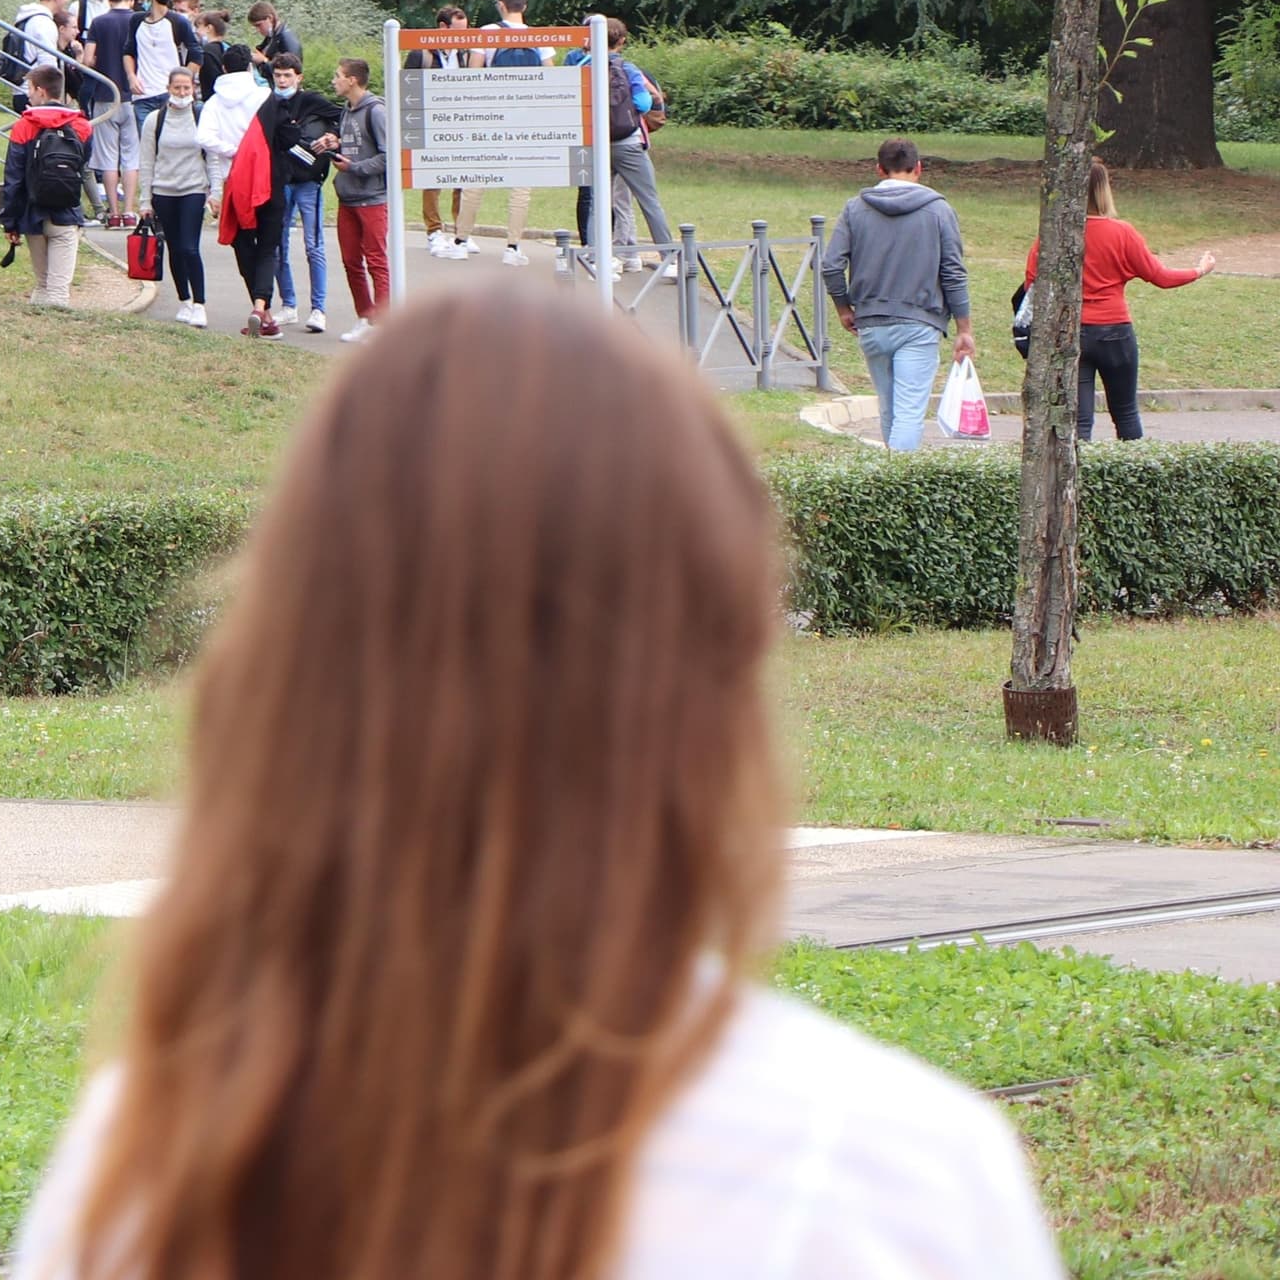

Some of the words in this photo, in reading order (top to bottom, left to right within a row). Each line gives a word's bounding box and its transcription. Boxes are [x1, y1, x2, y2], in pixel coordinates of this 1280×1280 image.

[420, 33, 483, 44] UNIVERSITÉ
[487, 34, 500, 43] DE
[505, 33, 573, 43] BOURGOGNE
[431, 73, 482, 82] Restaurant
[484, 72, 544, 82] Montmuzard
[454, 94, 462, 102] de
[432, 112, 452, 122] Pôle
[453, 112, 505, 122] Patrimoine
[433, 133, 464, 142] CROUS
[472, 131, 489, 142] Bât.
[491, 131, 503, 141] de
[504, 130, 513, 141] la
[515, 131, 529, 140] vie
[531, 130, 577, 141] étudiante
[420, 154, 451, 163] Maison
[436, 175, 457, 184] Salle
[459, 174, 505, 185] Multiplex
